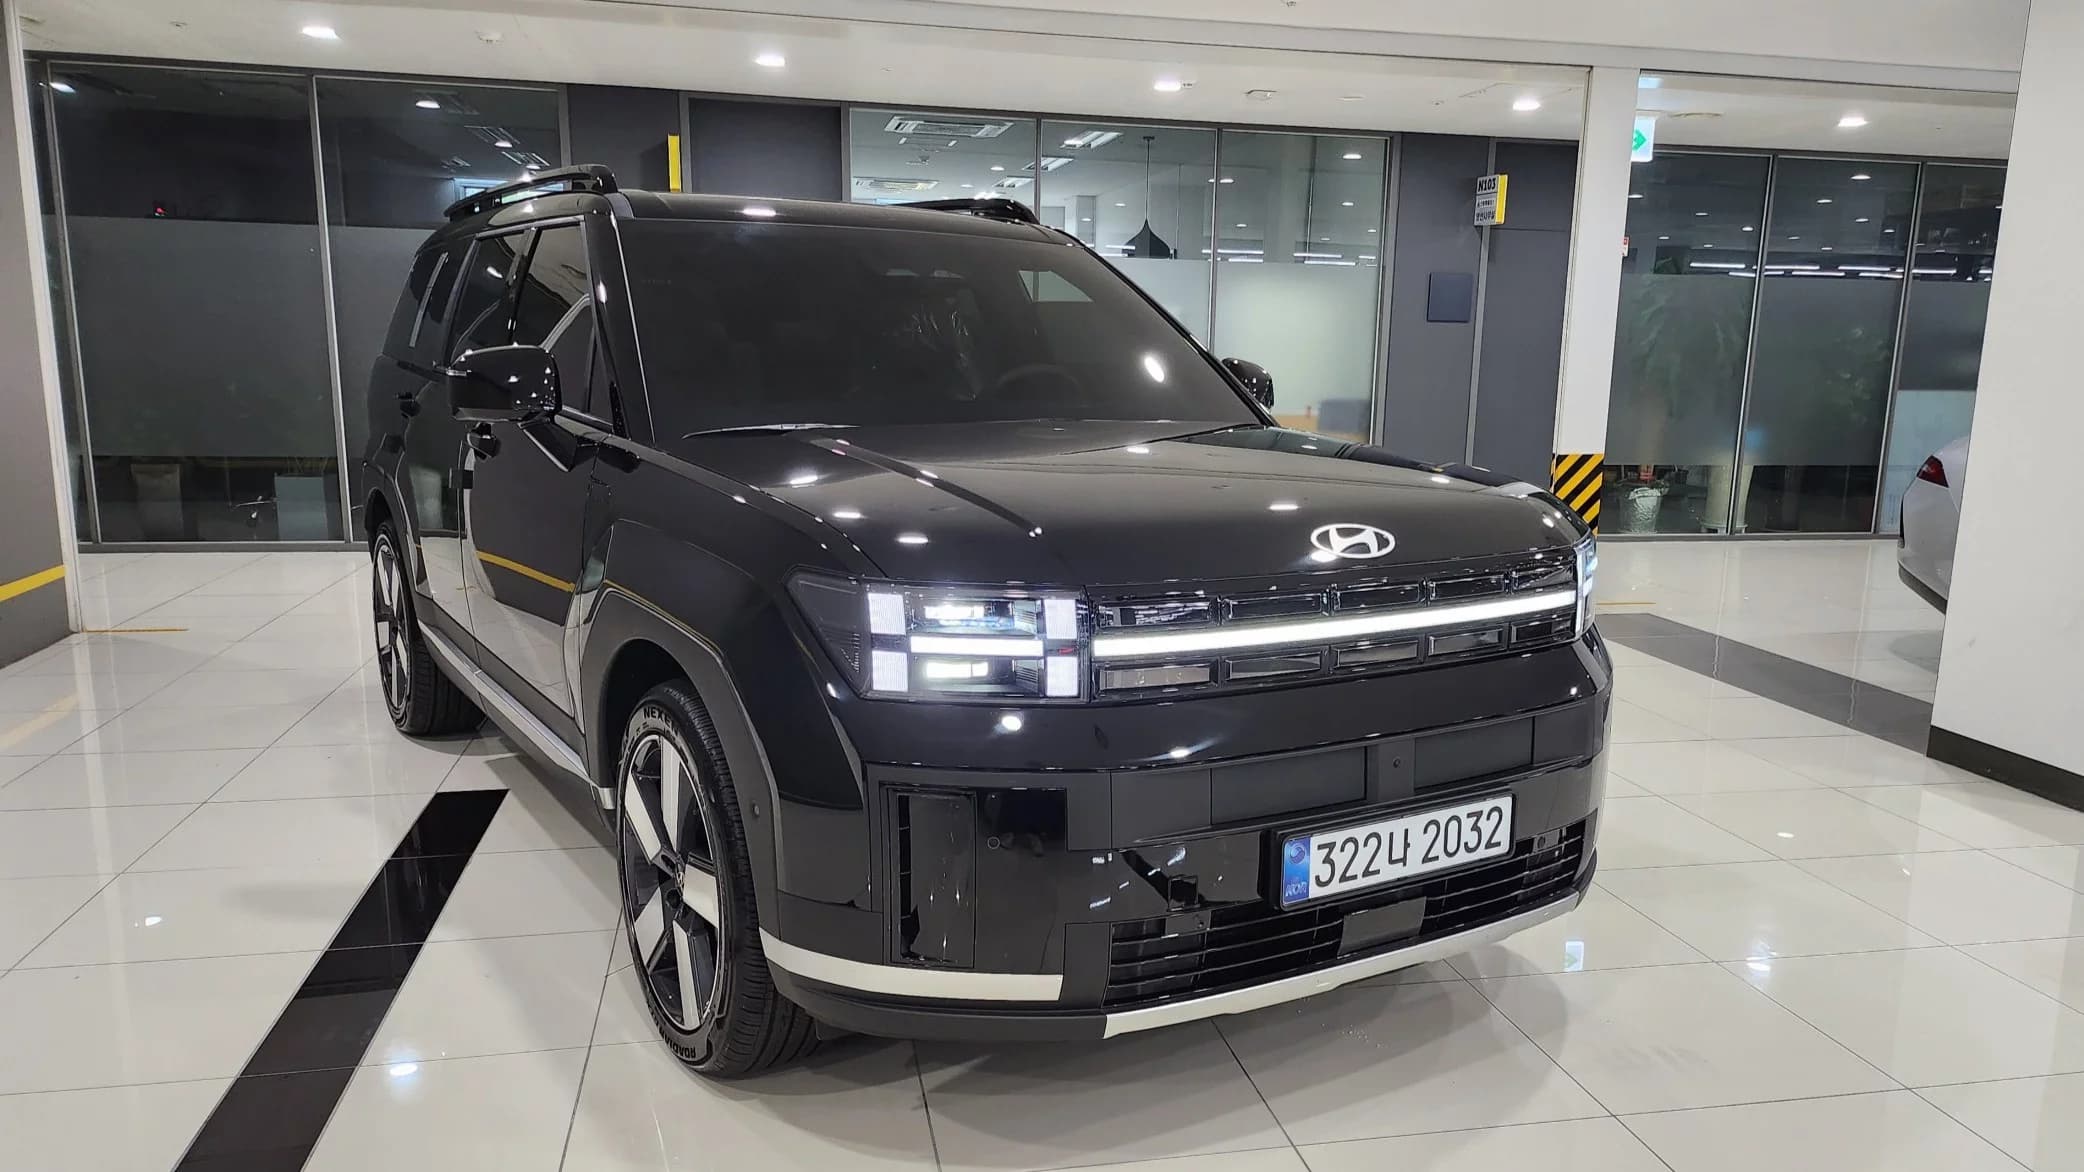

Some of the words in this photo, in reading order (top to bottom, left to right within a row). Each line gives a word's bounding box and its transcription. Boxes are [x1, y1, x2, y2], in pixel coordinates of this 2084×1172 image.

[1478, 178, 1496, 192] N103
[643, 706, 680, 736] NEXEN
[1315, 828, 1411, 888] 322나
[1421, 805, 1503, 865] 2032
